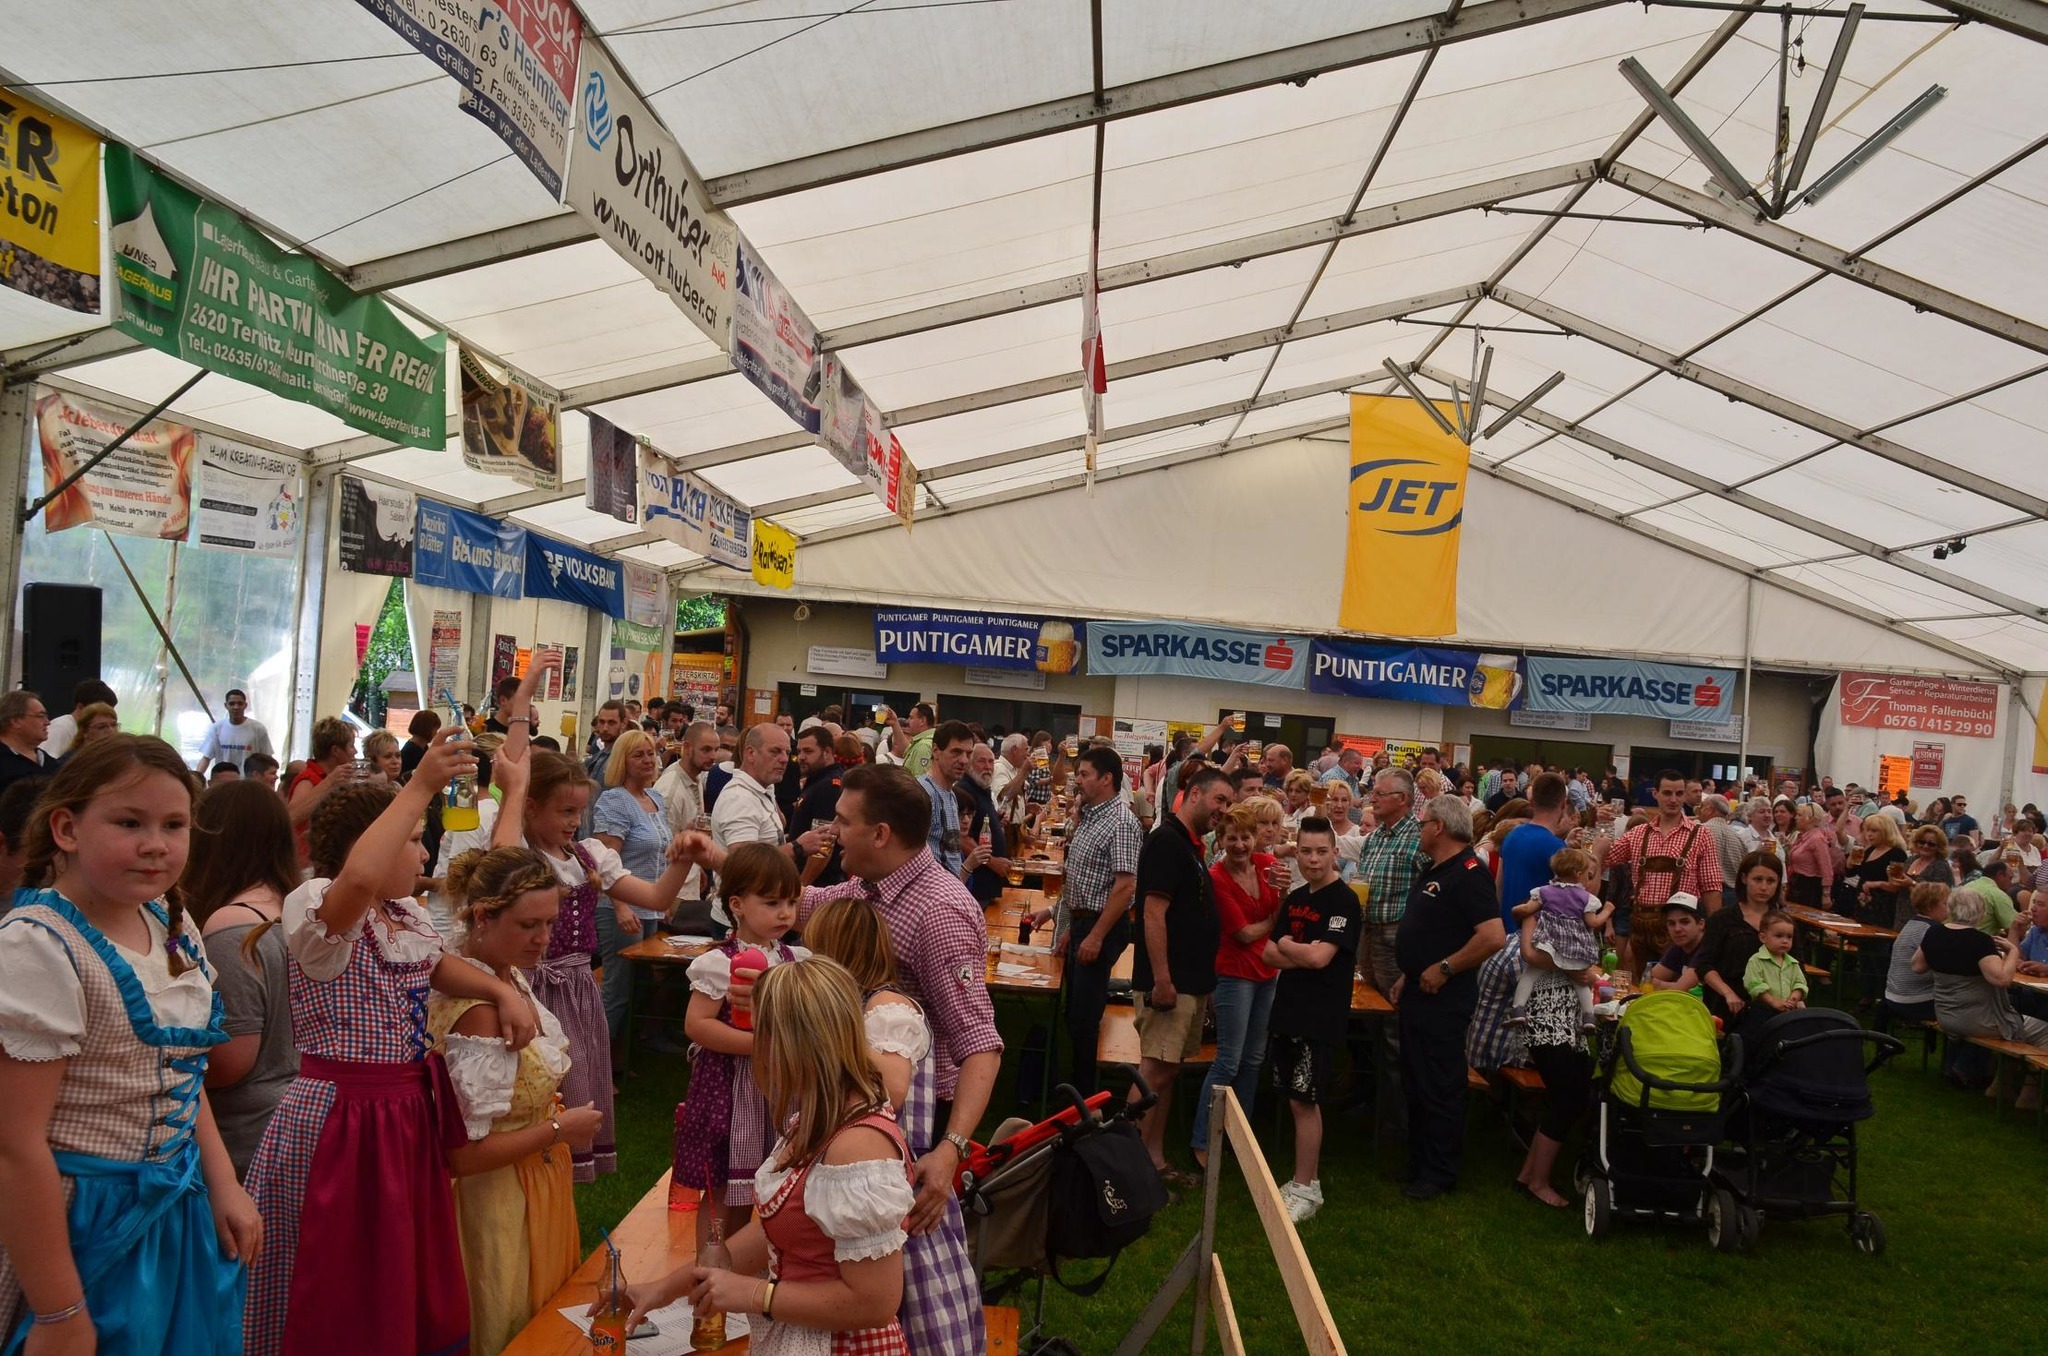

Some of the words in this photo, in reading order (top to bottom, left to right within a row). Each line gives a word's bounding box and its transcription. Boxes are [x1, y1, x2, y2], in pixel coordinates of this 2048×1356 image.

[440, 20, 470, 54] 2630
[435, 43, 470, 80] Gratis
[199, 256, 239, 306] IHR
[187, 332, 212, 355] Tel.:
[190, 302, 228, 334] 2620
[370, 382, 389, 403] 38
[210, 445, 227, 461] H-M
[1359, 478, 1458, 516] JET
[421, 512, 446, 535] Bezirks
[420, 532, 444, 553] Blätter
[452, 534, 472, 563] Bei
[563, 555, 616, 590] VOLKSBANK
[877, 613, 928, 622] PUNTIGAMER
[932, 613, 984, 625] PUNTIGAMER
[987, 616, 1039, 630] PUNTIGAMER
[879, 629, 1032, 660] PUNTIGAMER
[1101, 634, 1262, 667] SPARKASSE
[1314, 653, 1467, 689] PUNTIGAMER
[1541, 673, 1692, 705] SPARKASSE
[1890, 678, 1939, 690] Gartenpflege
[1948, 683, 1996, 696] Winterdienst
[1890, 687, 1916, 696] Service
[1924, 690, 1993, 704] Reparaturarbeiten
[1884, 714, 1917, 728] 0676
[1927, 718, 1951, 732] 415
[1955, 721, 1972, 733] 29
[1974, 723, 1992, 736] 90
[1888, 701, 1928, 714] Thomas
[1931, 705, 1993, 721] Fallenbüchl
